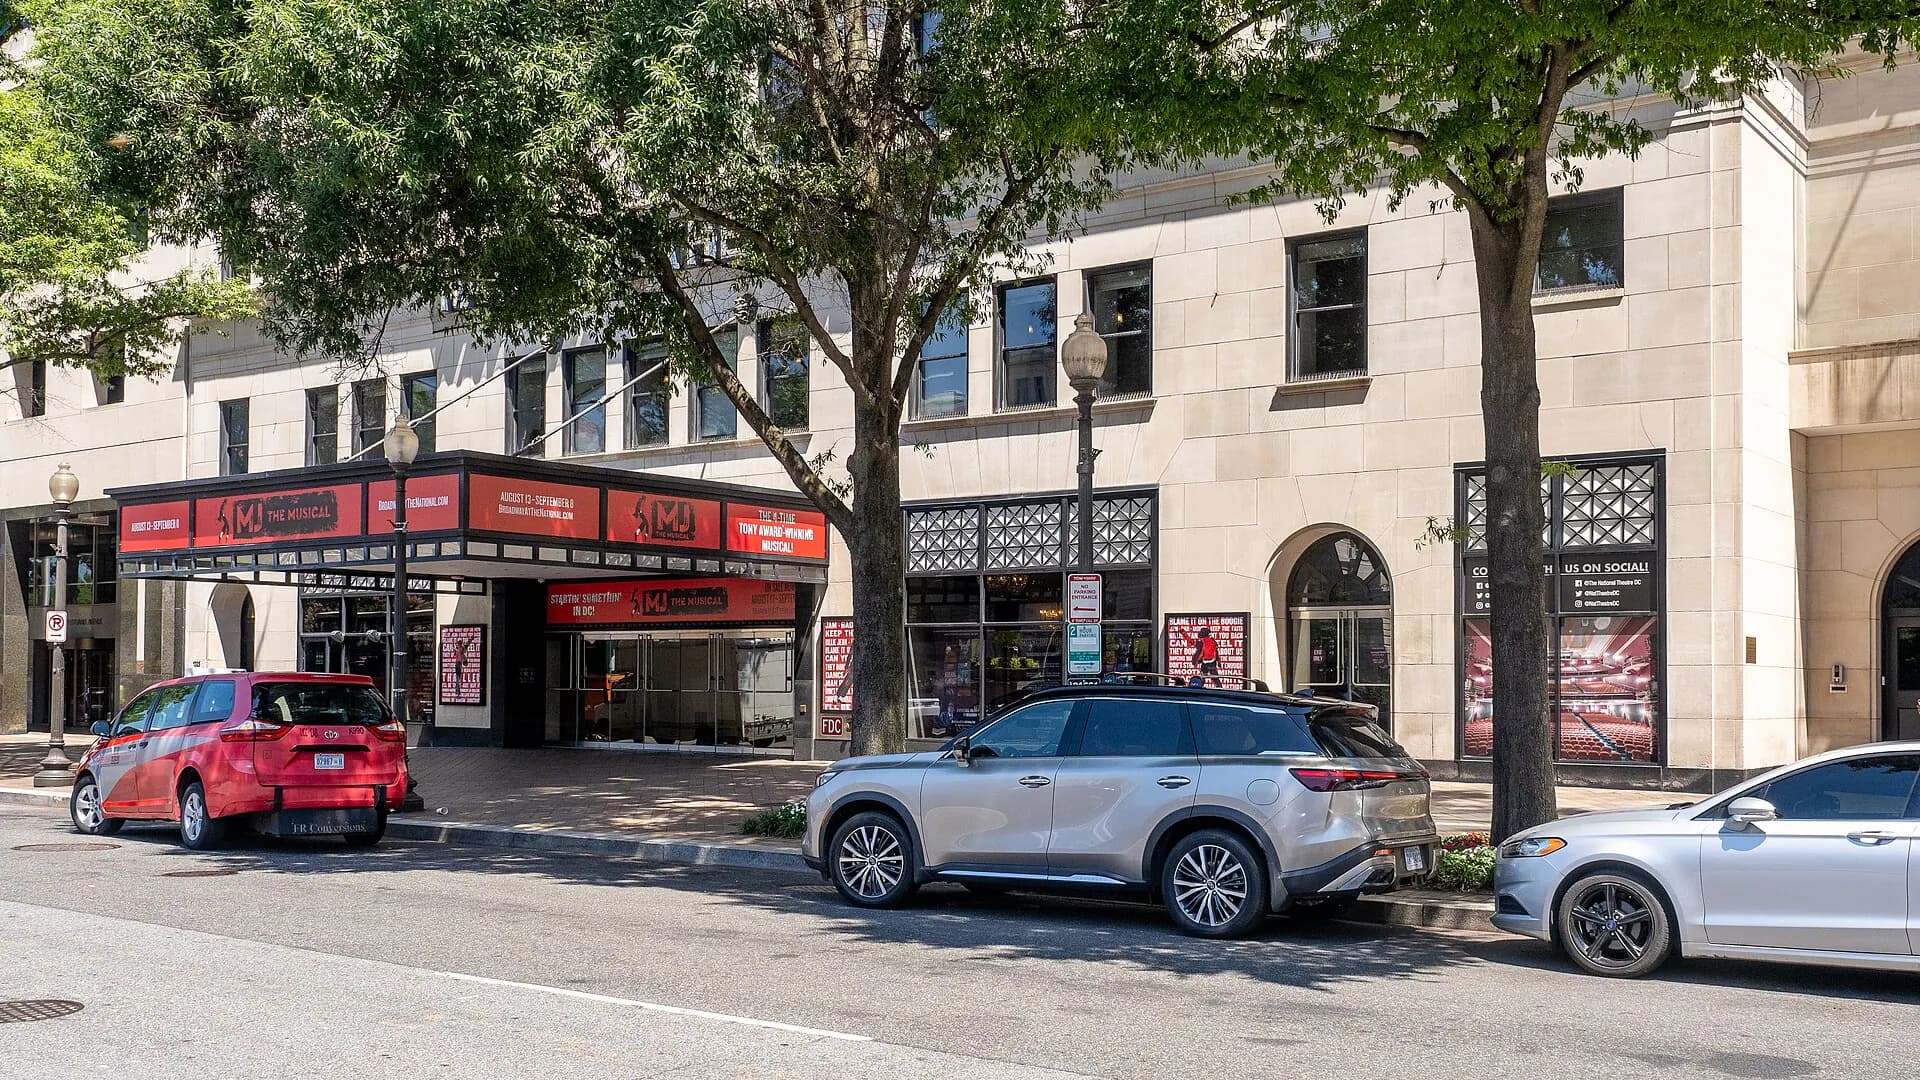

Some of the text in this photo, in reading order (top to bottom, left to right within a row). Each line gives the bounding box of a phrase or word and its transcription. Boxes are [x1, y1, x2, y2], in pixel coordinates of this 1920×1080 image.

[500, 491, 524, 504] AUGUST
[570, 498, 575, 509] 8
[237, 503, 331, 534] MJ THE MUSICAL
[656, 501, 690, 533] MJ
[758, 510, 772, 523] THE
[738, 522, 758, 535] TONY
[655, 530, 690, 540] THE MUSICAL
[761, 541, 794, 553] MUSICAL!
[1565, 564, 1580, 573] US
[1582, 563, 1601, 573] ON
[1604, 562, 1649, 572] SOCIAL!
[645, 591, 723, 613] MJ THE MUSICAL
[573, 605, 595, 616] IN DC!
[825, 621, 837, 629] JAM
[1169, 616, 1244, 626] BLAME IT ON THE BOOGIE
[825, 629, 854, 637] KEEP TH
[1070, 626, 1077, 636] 2
[1170, 639, 1187, 648] CAN
[1234, 639, 1244, 648] IT
[825, 654, 838, 662] CAN
[822, 718, 841, 734] FDC
[309, 823, 367, 833] Conversions
